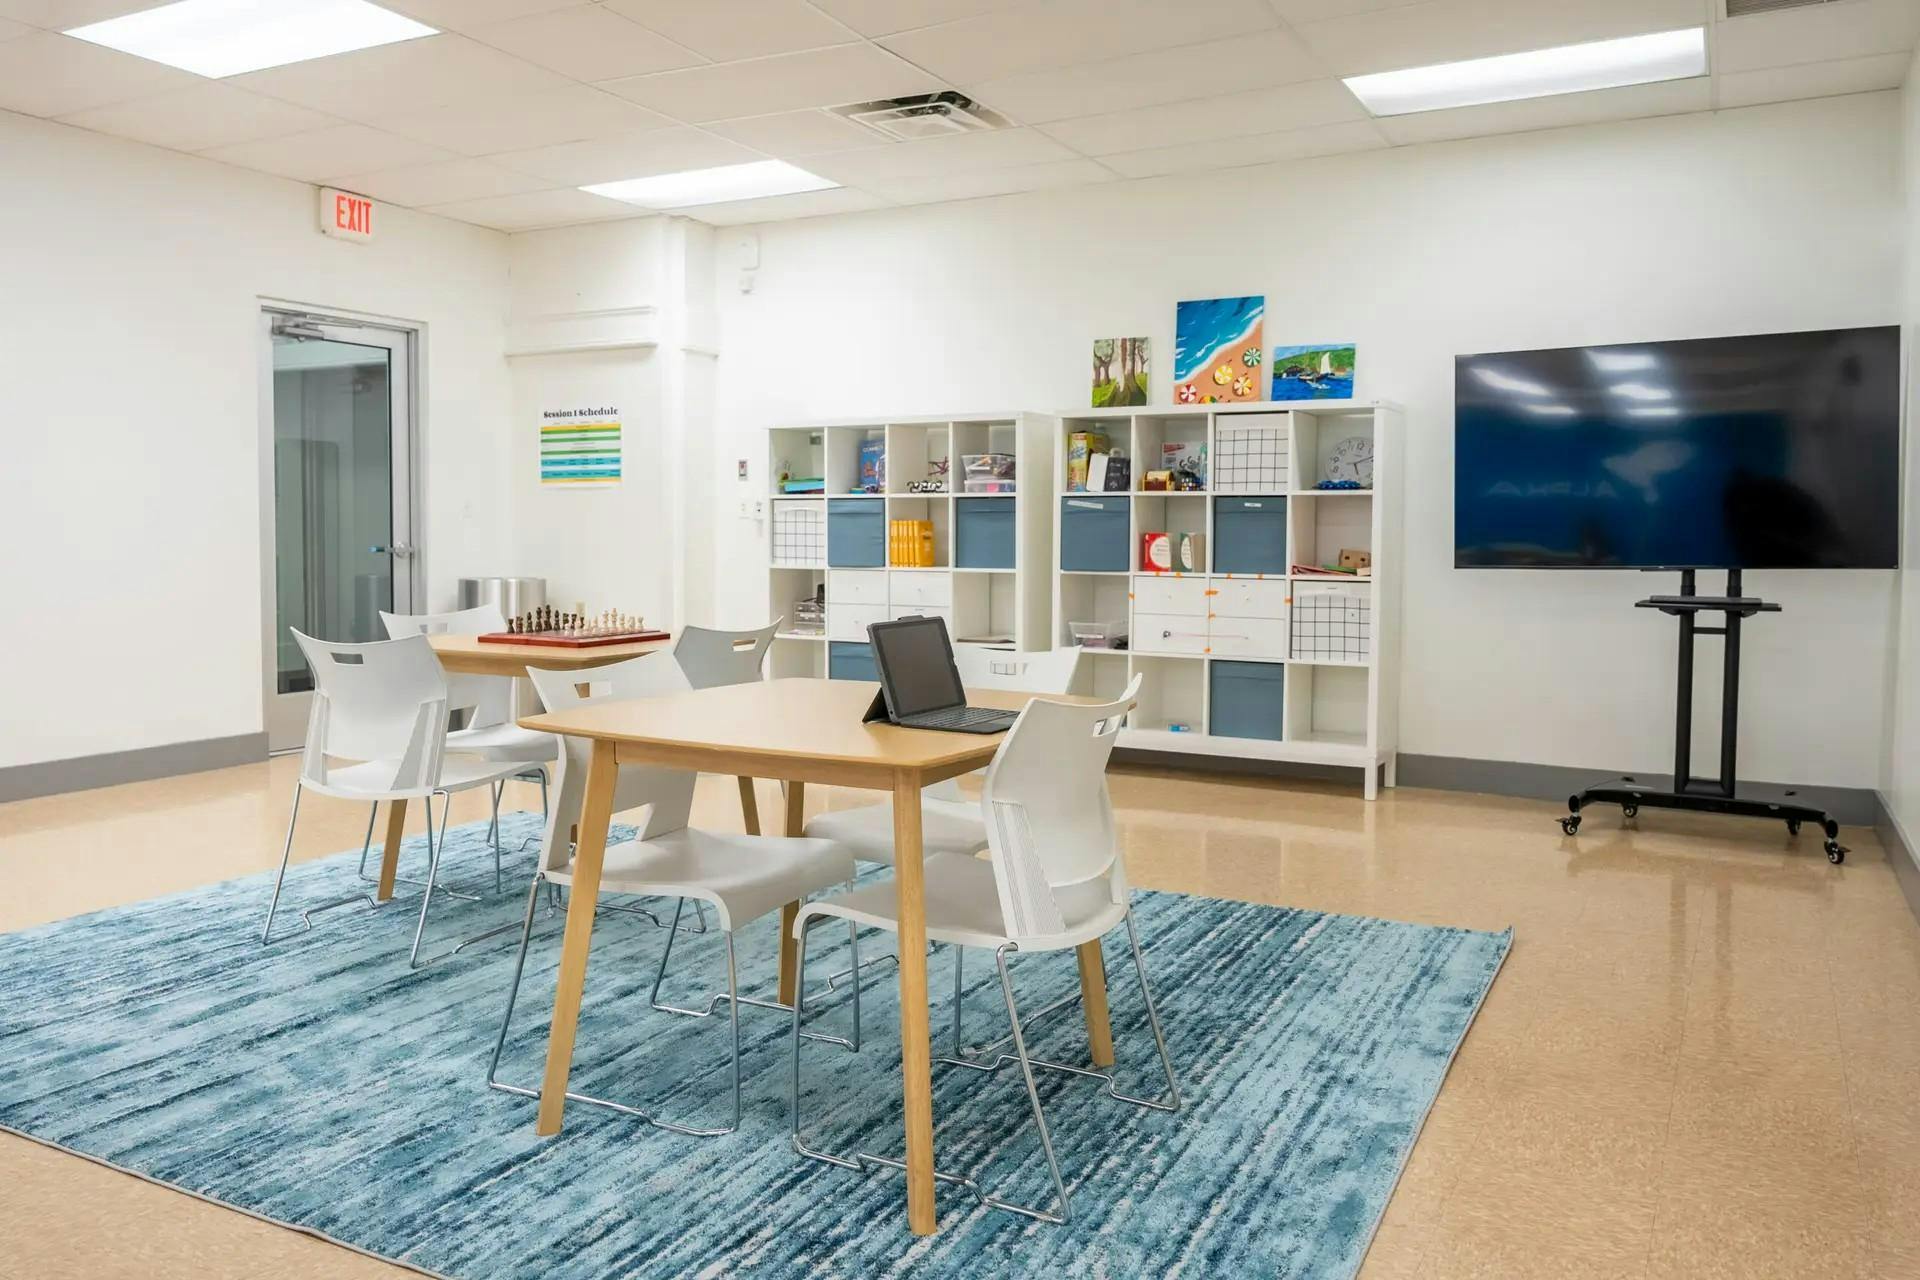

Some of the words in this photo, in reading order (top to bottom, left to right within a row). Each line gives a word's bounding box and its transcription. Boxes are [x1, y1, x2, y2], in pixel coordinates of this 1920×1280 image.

[336, 195, 372, 234] EXIT
[543, 410, 573, 418] Session
[578, 407, 618, 416] Schedule
